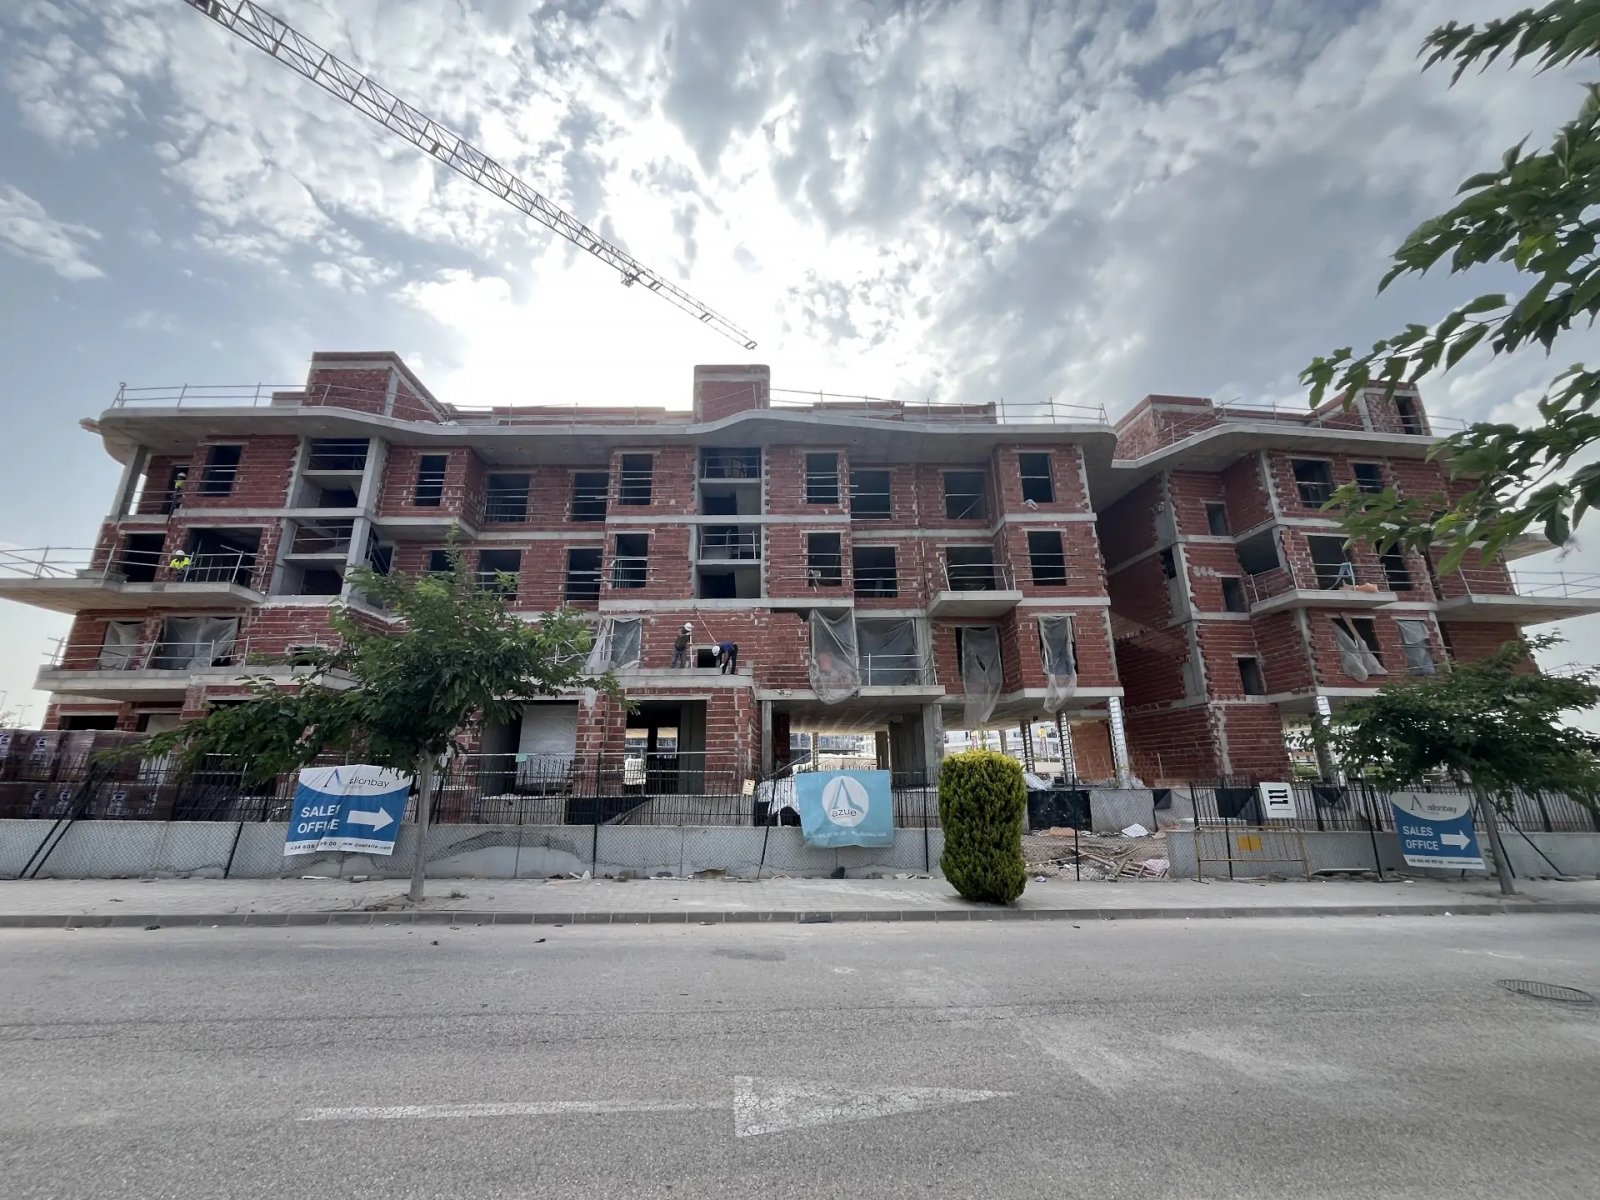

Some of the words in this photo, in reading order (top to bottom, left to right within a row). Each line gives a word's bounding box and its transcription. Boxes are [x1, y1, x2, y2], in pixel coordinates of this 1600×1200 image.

[297, 819, 340, 834] OFFIE
[1402, 825, 1434, 837] SALES
[1405, 839, 1440, 851] OFFICE
